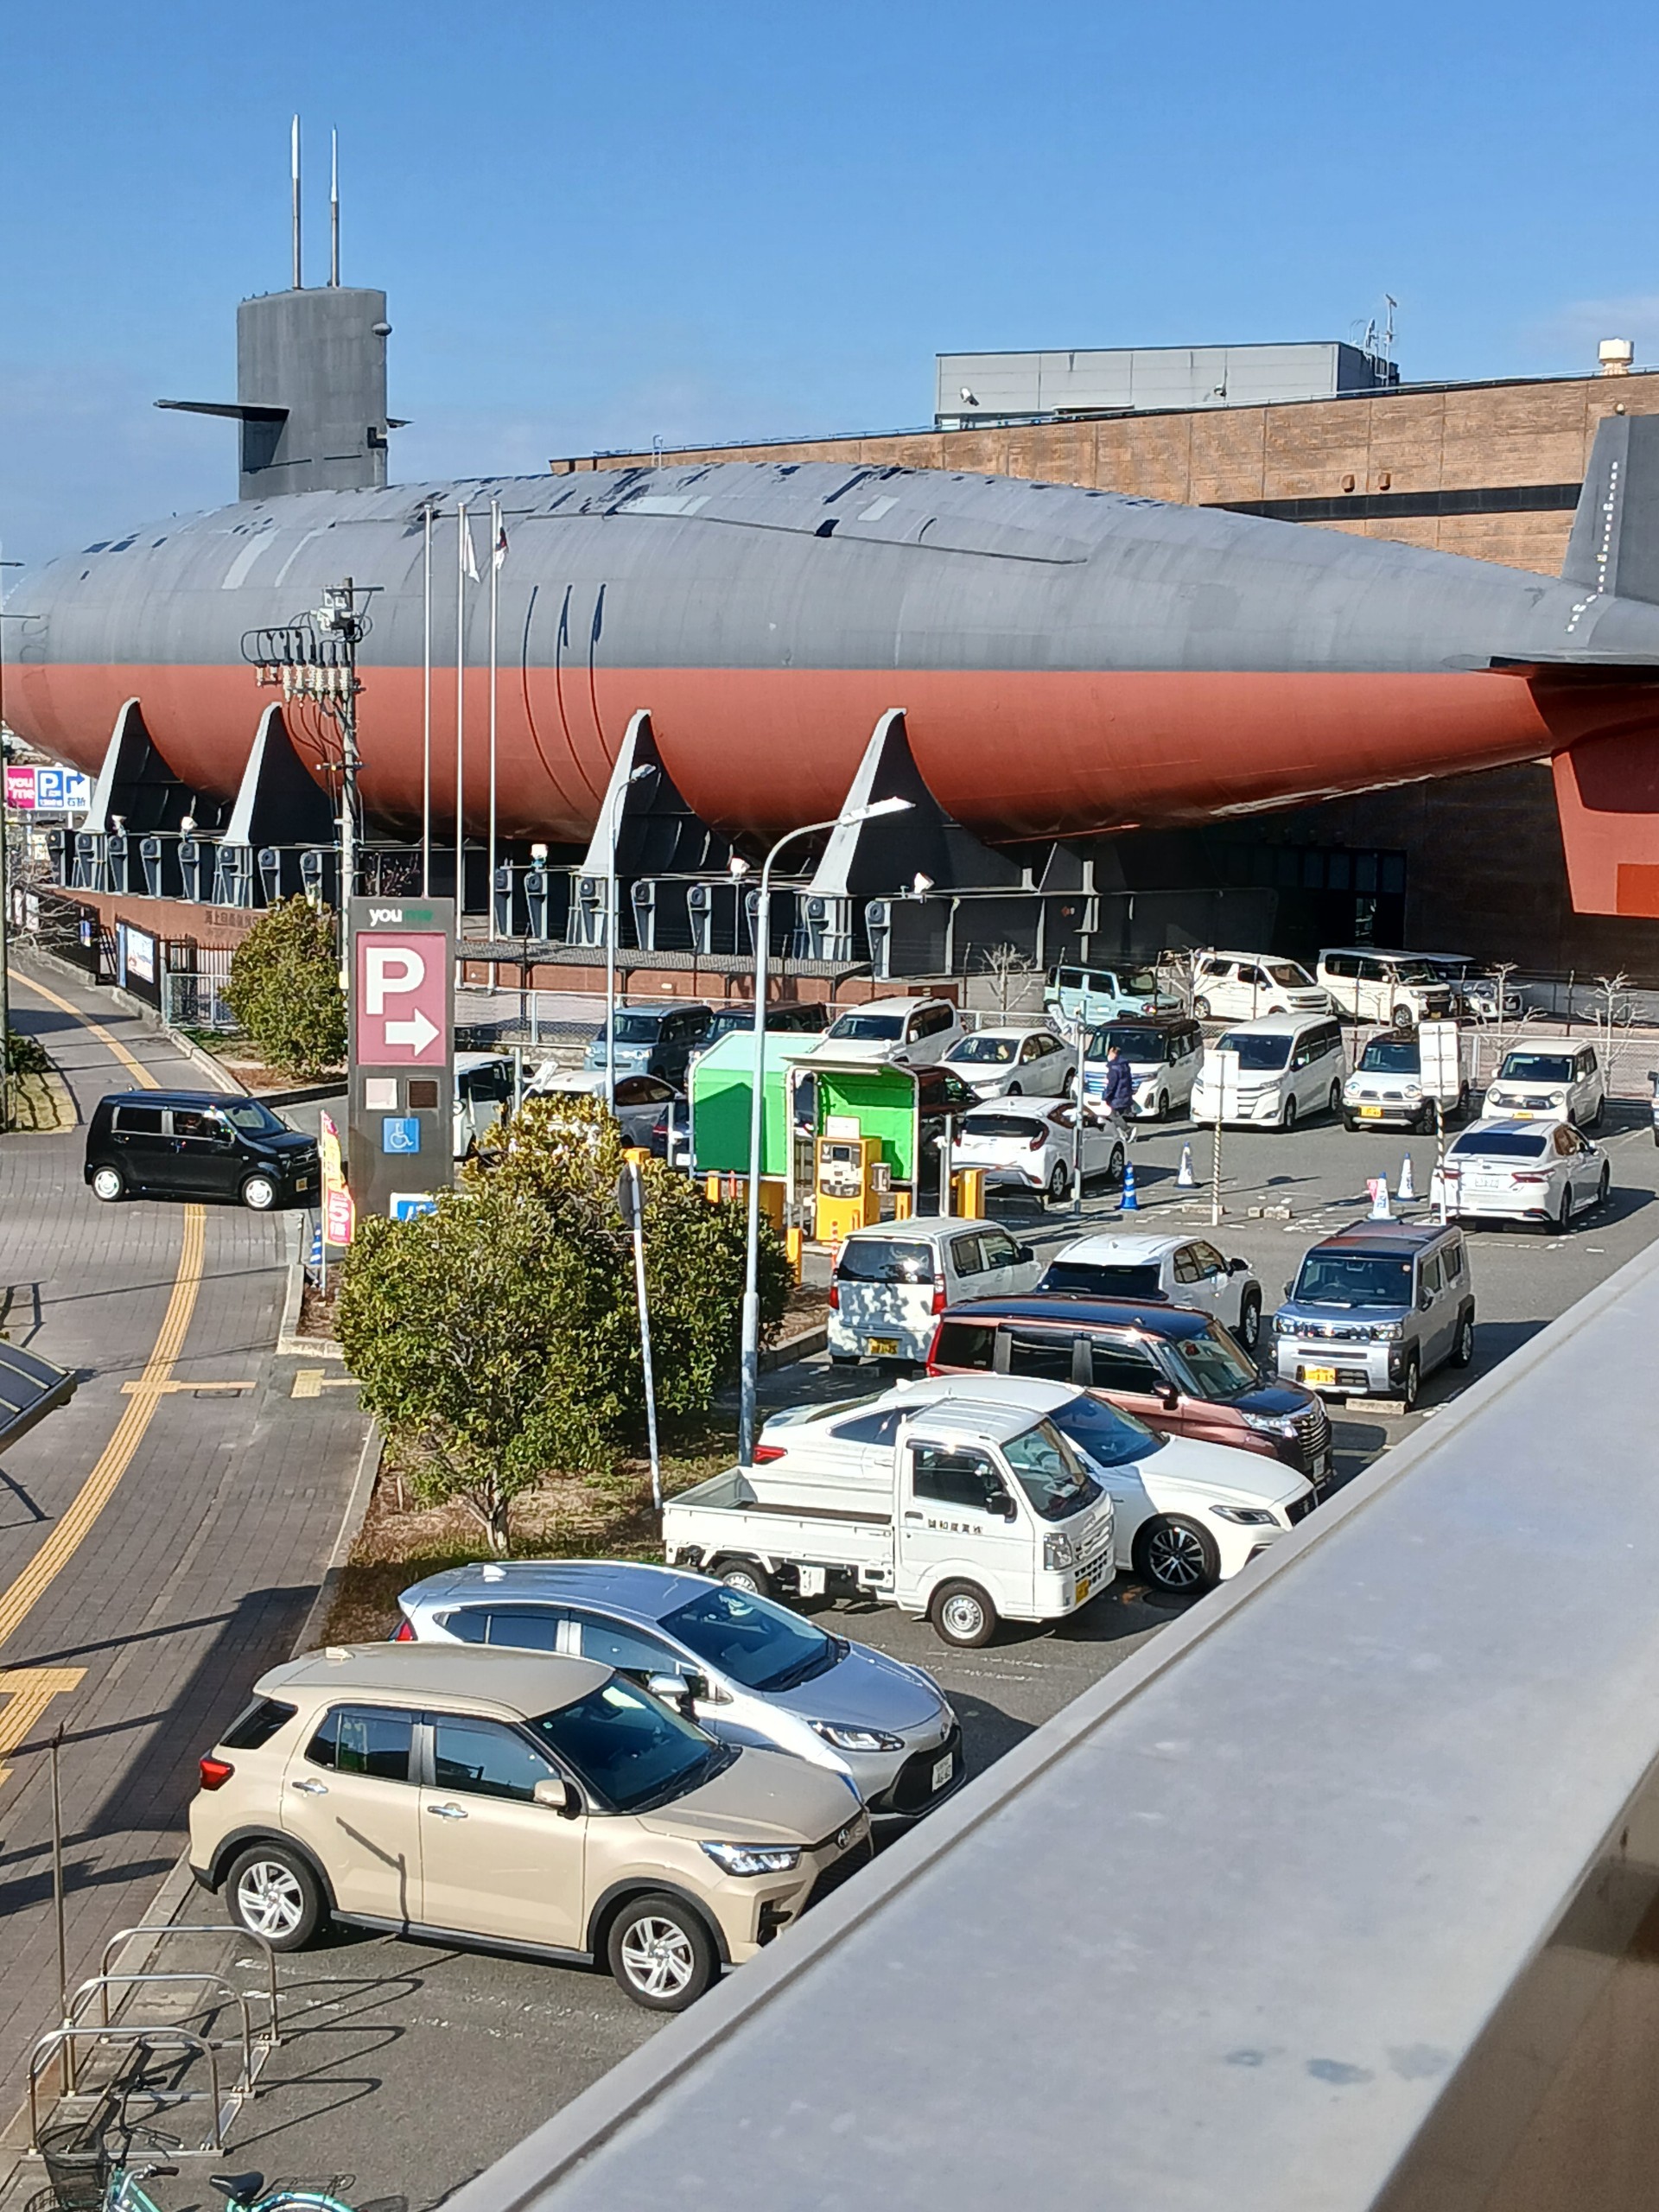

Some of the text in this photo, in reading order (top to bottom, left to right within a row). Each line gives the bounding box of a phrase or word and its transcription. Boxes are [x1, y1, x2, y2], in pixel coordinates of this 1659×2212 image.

[9, 778, 34, 791] you
[13, 789, 35, 799] me
[40, 772, 59, 798] P
[366, 947, 425, 1014] P
